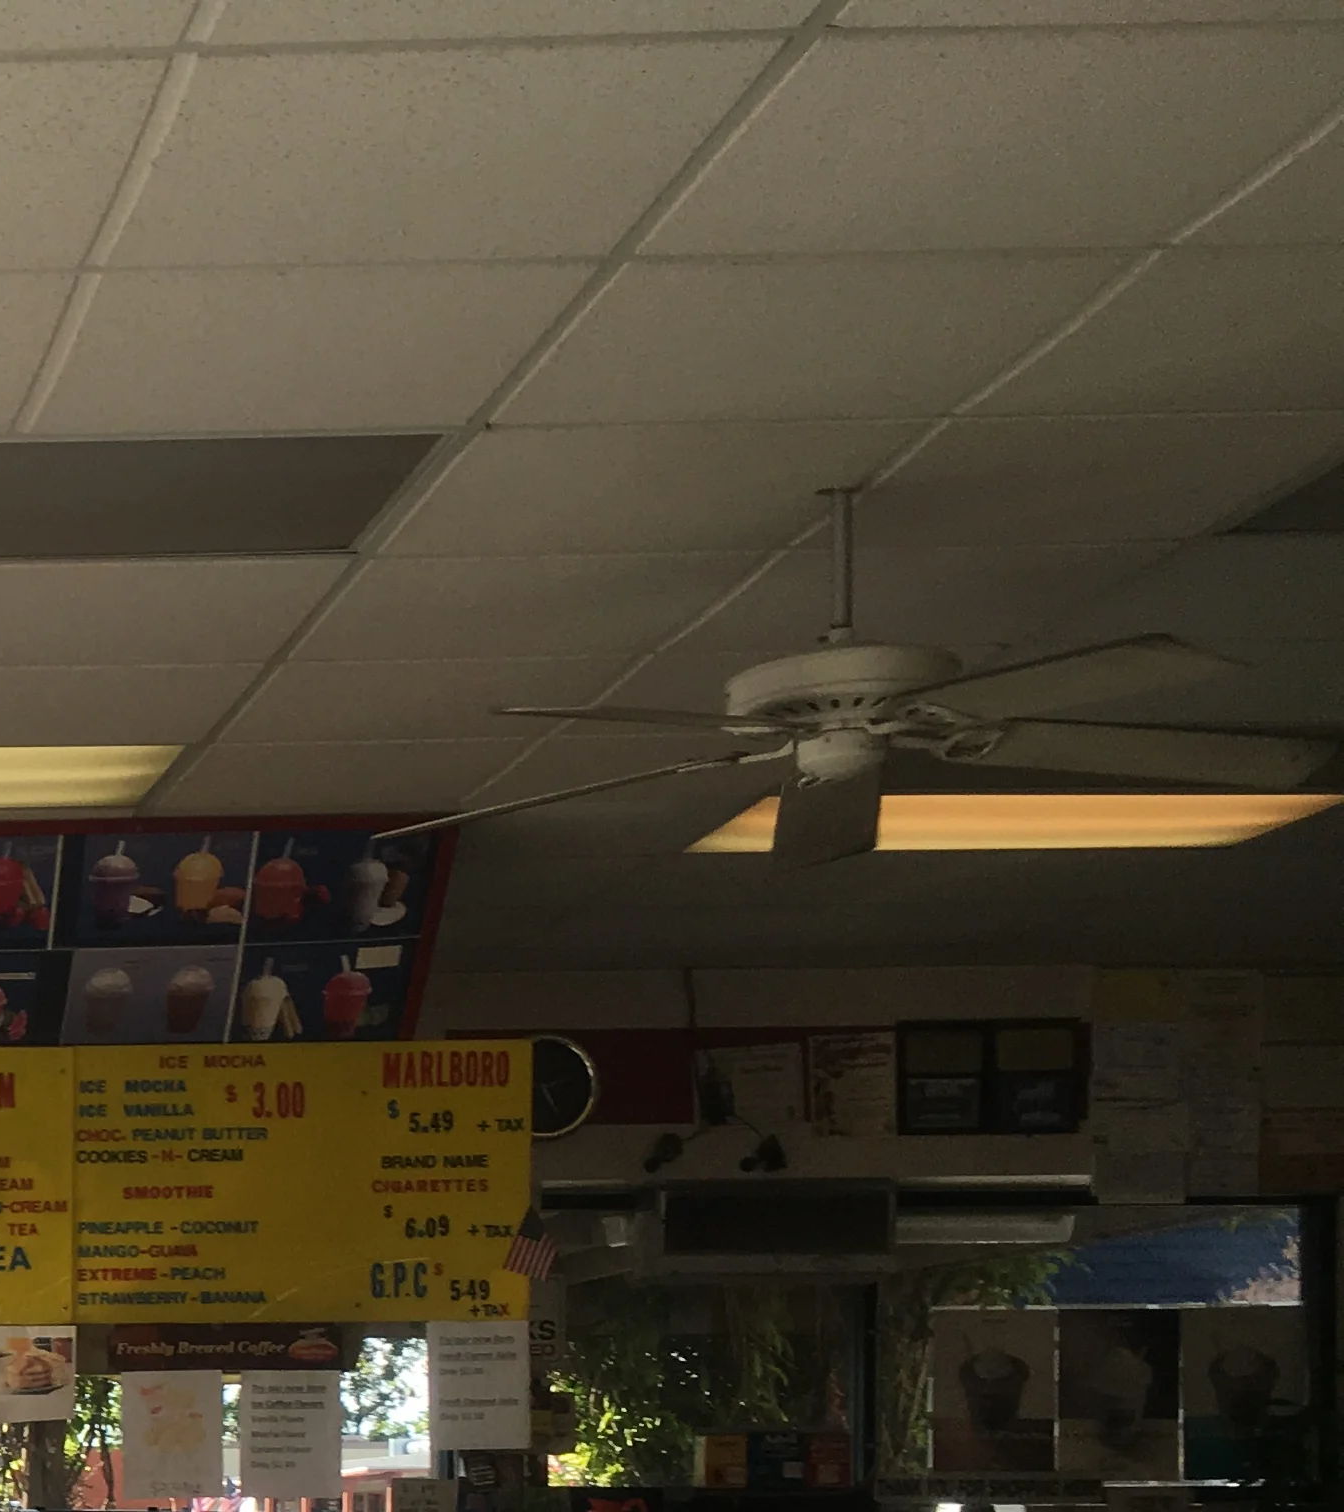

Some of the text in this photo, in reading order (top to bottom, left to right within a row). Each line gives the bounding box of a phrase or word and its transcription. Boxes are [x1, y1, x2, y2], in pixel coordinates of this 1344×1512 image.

[159, 1054, 267, 1069] ICE MOCHA
[382, 1051, 510, 1088] MARLBORO
[78, 1079, 187, 1094] ICE MOCHA
[251, 1081, 306, 1118] 3.00
[77, 1103, 194, 1118] ICE VANILLA
[408, 1111, 454, 1135] 5.49
[495, 1118, 525, 1133] TAX
[132, 1127, 197, 1142] PEANUT
[202, 1126, 268, 1141] BUTTER
[77, 1149, 148, 1164] COOKIES
[187, 1148, 244, 1163] CREAM
[381, 1154, 490, 1169] BRAND NAME
[123, 1184, 214, 1200] SMOOTHIE
[372, 1179, 490, 1194] CIGARETTES
[7, 1223, 39, 1237] TEA
[77, 1220, 164, 1235] PINEAPPLE
[405, 1215, 450, 1239] 6.09
[484, 1223, 513, 1238] TAX
[116, 1340, 286, 1357] Freshly Brewed Coffee
